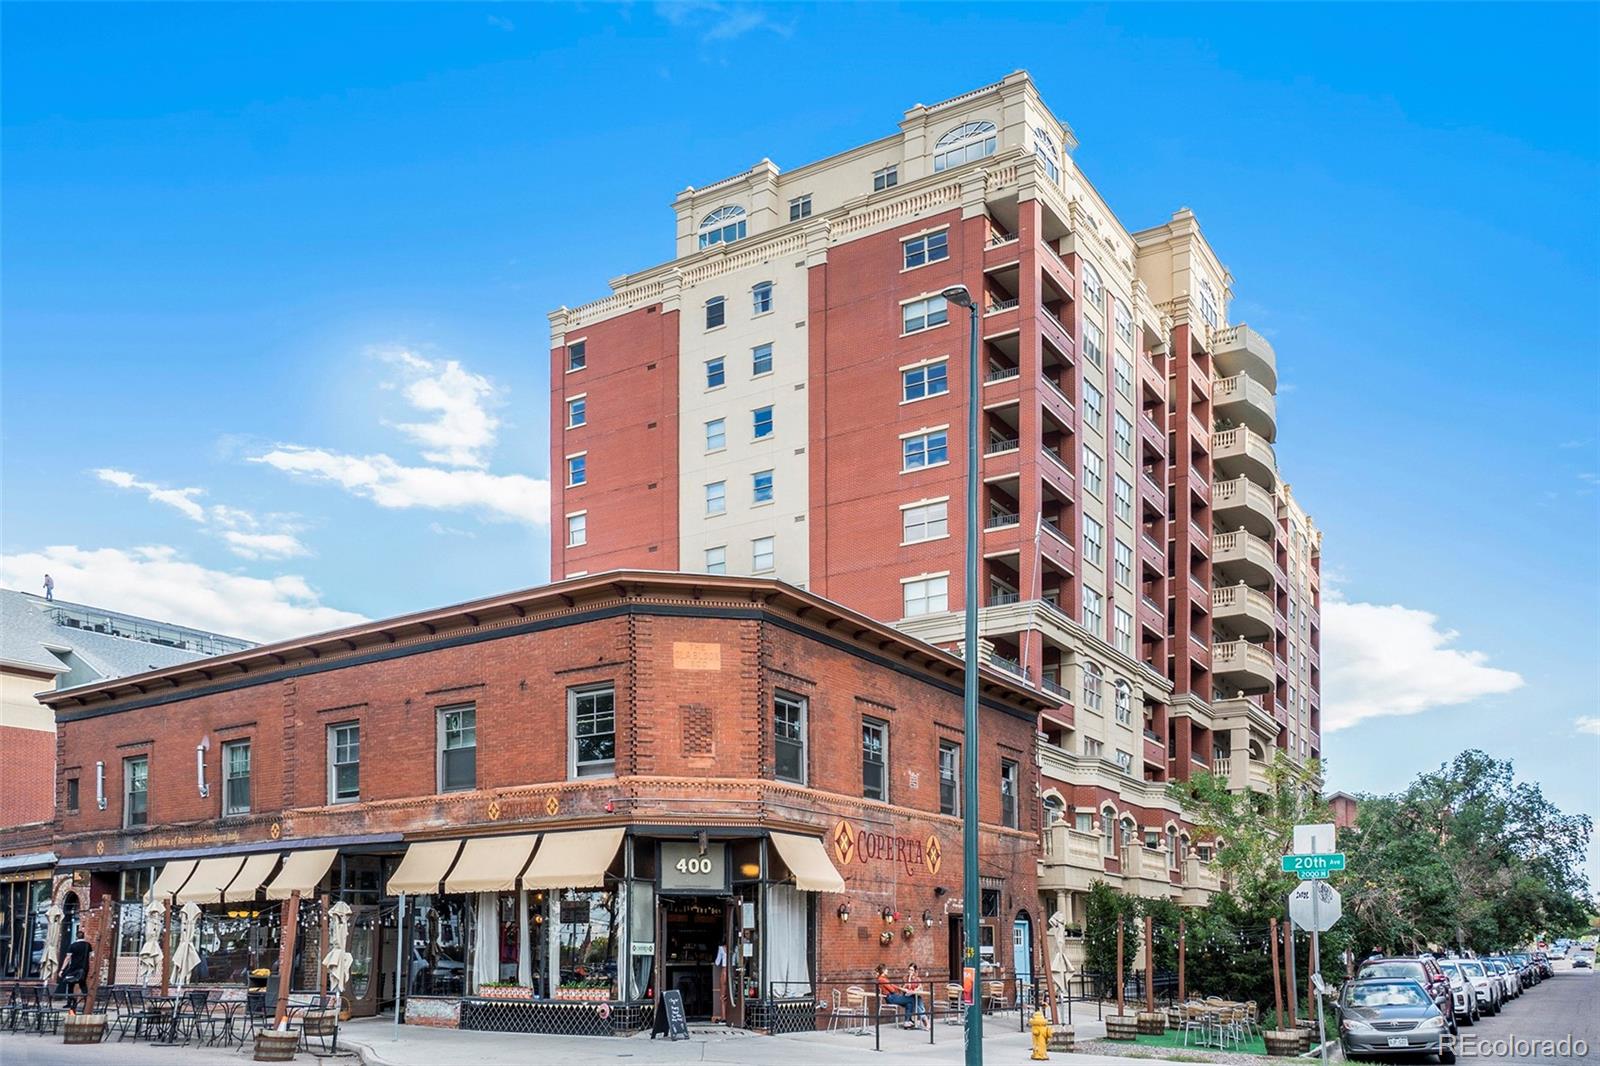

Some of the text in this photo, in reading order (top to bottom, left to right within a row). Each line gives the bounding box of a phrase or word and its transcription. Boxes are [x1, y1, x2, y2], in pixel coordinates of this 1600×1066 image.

[192, 835, 203, 843] and
[857, 830, 924, 876] COPERTA
[676, 858, 712, 873] 400
[1295, 857, 1327, 869] 20th
